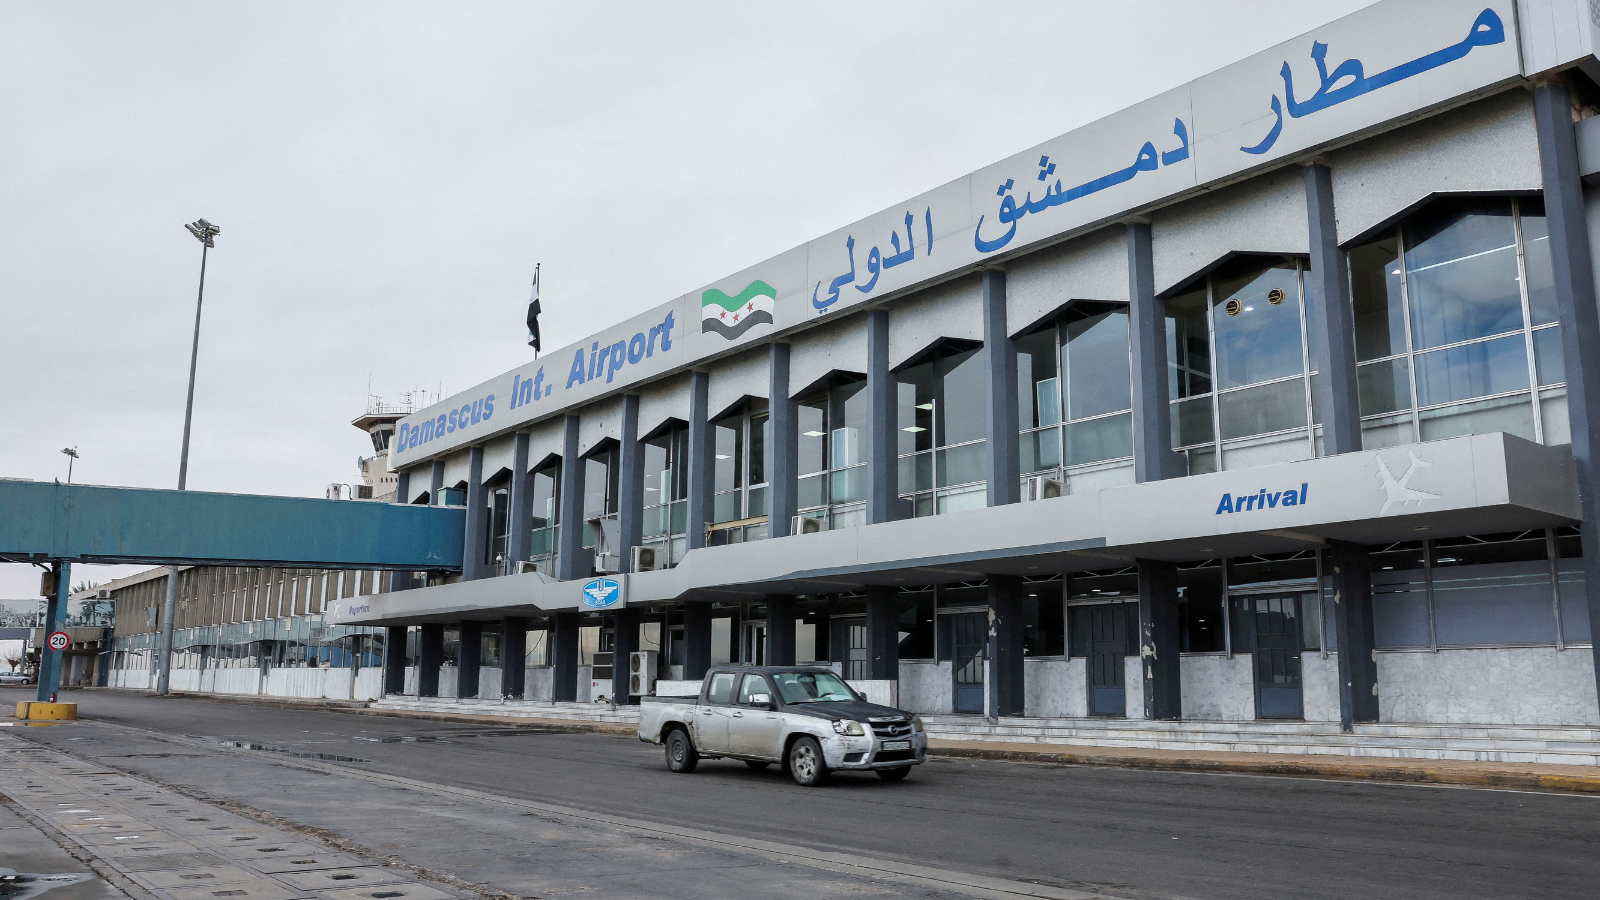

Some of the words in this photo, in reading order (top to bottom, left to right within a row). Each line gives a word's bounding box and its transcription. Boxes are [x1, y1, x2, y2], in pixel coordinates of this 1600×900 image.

[1240, 7, 1505, 154] مطار
[974, 118, 1190, 253] دمشق
[812, 207, 934, 314] الدولي
[397, 394, 495, 453] Damascus
[510, 366, 552, 410] Int.
[566, 310, 675, 389] Airport
[1216, 483, 1308, 515] Arrival
[51, 637, 66, 646] 20
